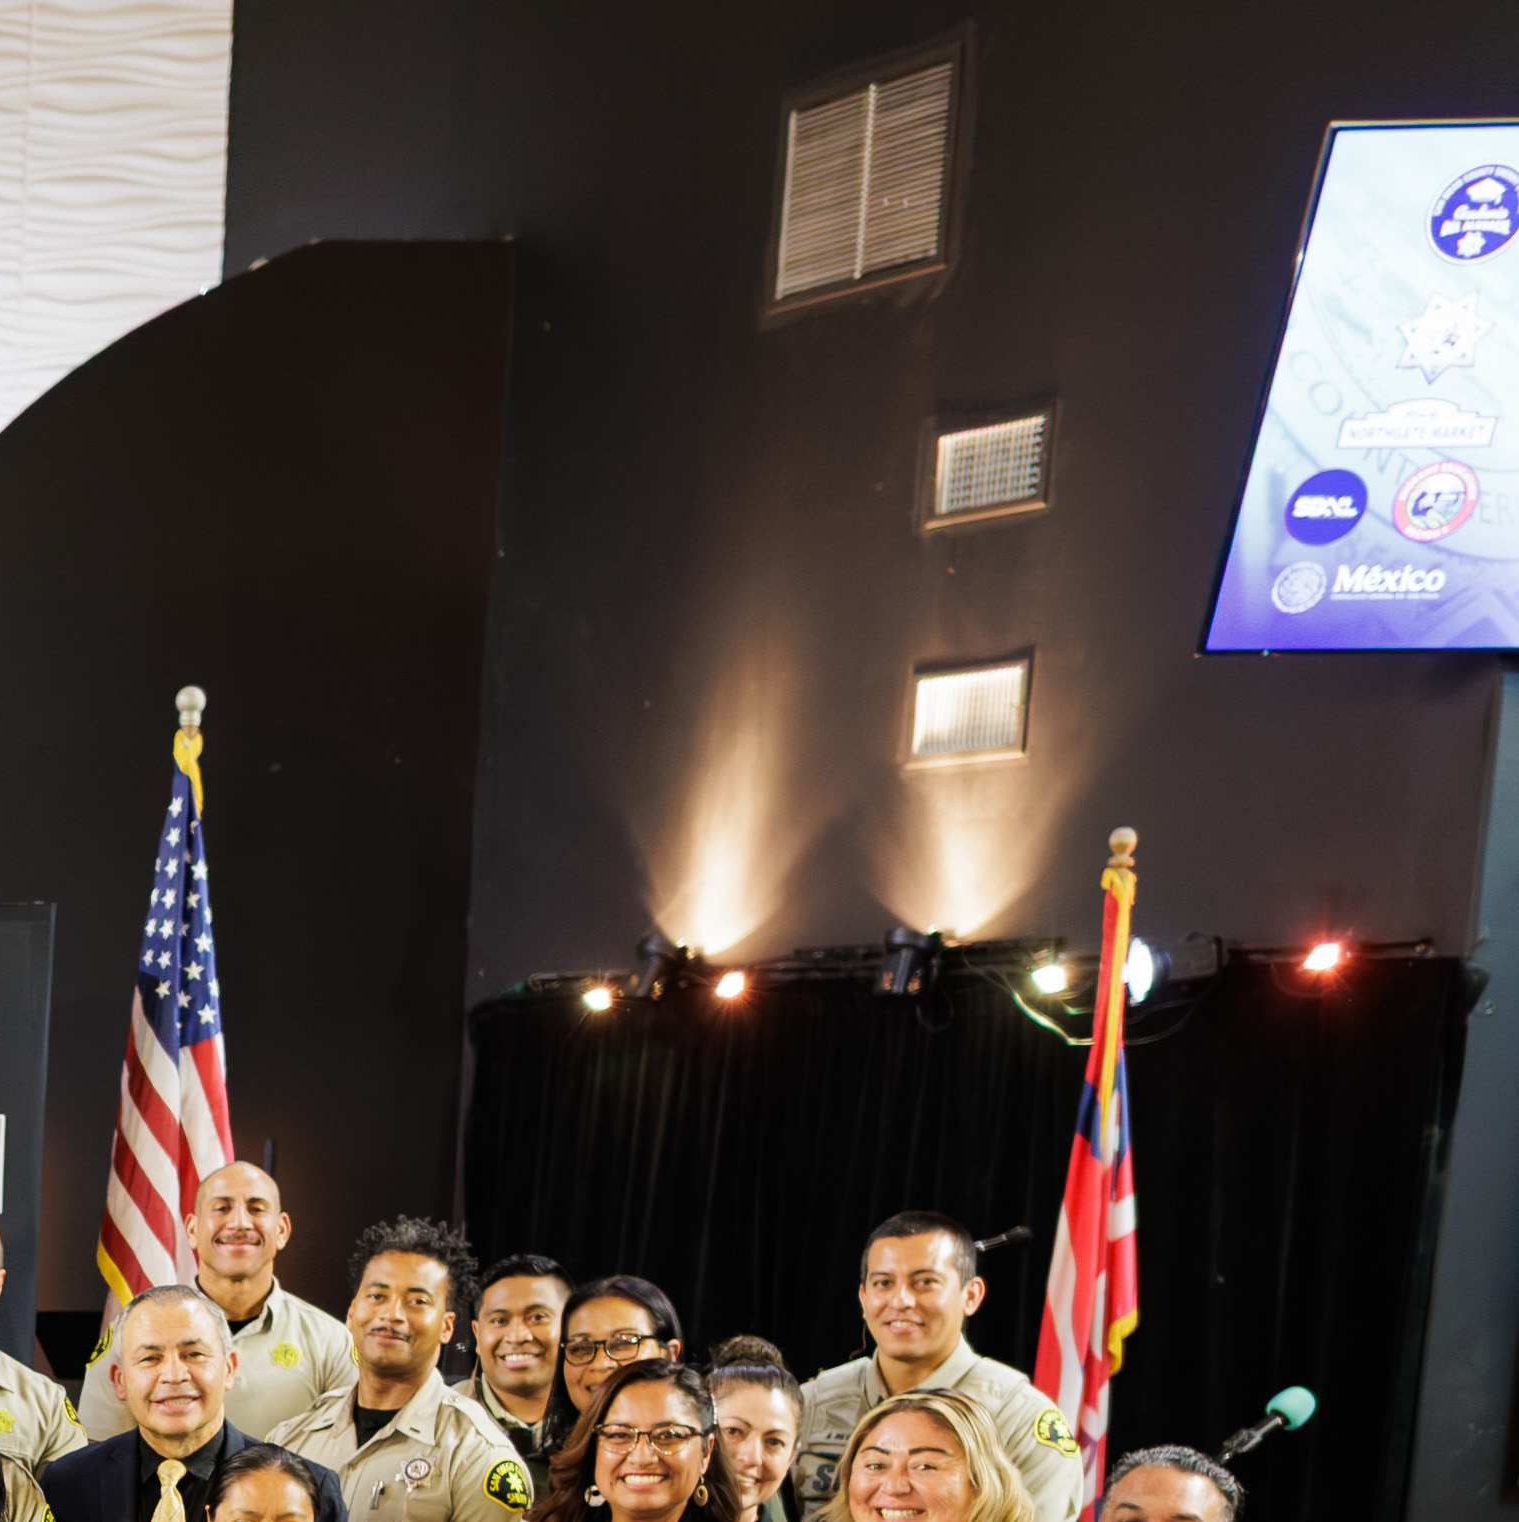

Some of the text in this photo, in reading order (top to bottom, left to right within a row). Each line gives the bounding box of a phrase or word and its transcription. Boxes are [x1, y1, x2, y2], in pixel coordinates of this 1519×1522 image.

[1348, 426, 1485, 439] NORTHGATE MARKET
[1332, 564, 1446, 593] México
